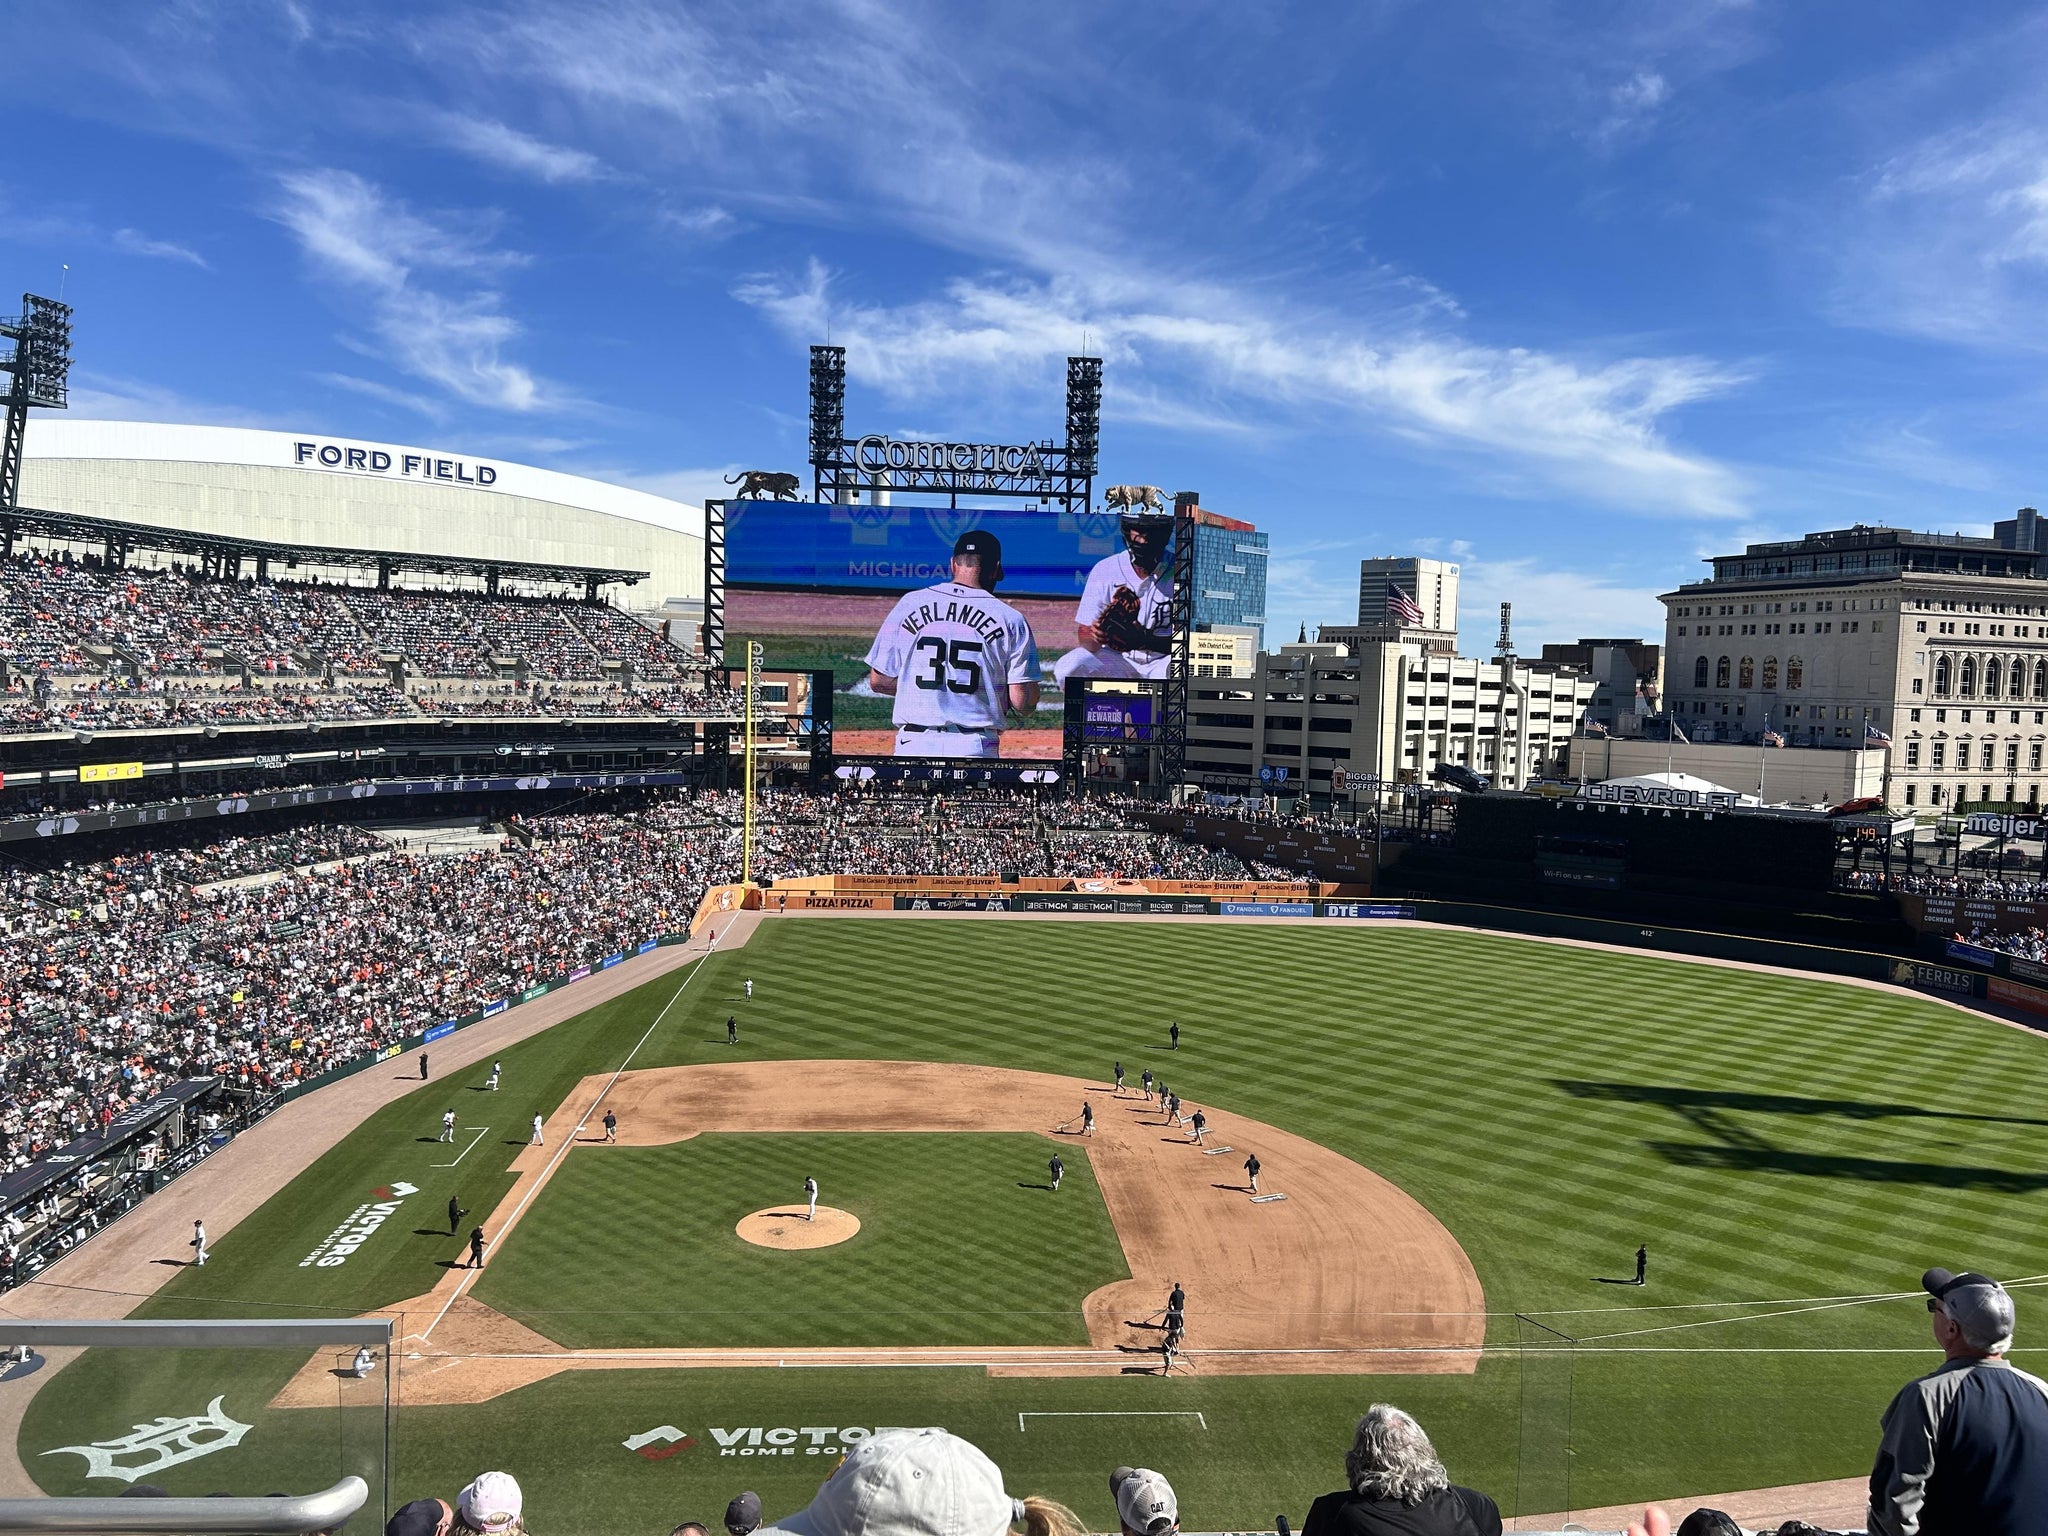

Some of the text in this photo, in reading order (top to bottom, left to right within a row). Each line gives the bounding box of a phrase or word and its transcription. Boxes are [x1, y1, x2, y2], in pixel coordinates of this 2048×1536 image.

[294, 441, 497, 487] FORD FIELD
[908, 471, 999, 489] PARK
[901, 602, 1005, 644] VERLANDER
[915, 636, 983, 695] 35
[751, 656, 764, 708] Rocket
[1086, 711, 1122, 722] REWARDS
[514, 742, 555, 751] Gallagher
[256, 753, 294, 765] CHAMPINS
[1345, 772, 1378, 781] BIGGBY
[1345, 782, 1378, 791] COFFEE
[1585, 783, 1742, 809] CHEVROLET
[1556, 801, 1714, 821] FOUNTAIN
[1968, 815, 2039, 837] meijer
[1286, 831, 1291, 839] 2
[1321, 836, 1329, 845] 16
[1266, 844, 1275, 853] 47
[1360, 843, 1366, 851] 6
[1543, 869, 1562, 878] Wi-Fi
[887, 877, 918, 885] DELIVERY
[966, 878, 996, 886] DELIVERY
[805, 898, 874, 908] PIZZA! PIZZA!
[1033, 902, 1068, 910] BETMGM
[1078, 902, 1113, 911] BETMGM
[1925, 899, 1956, 907] HEILMANN
[1965, 902, 1996, 911] JENNINGS
[1328, 905, 1358, 917] DTE
[1927, 907, 1953, 915] MANUSH
[2007, 905, 2036, 914] HARWELL
[1923, 915, 1955, 924] COCHRANE
[1963, 911, 1997, 920] CRAWFORD
[1971, 920, 1987, 928] KELL
[1917, 966, 1970, 987] FERRIS
[375, 1044, 402, 1062] bet365
[298, 1203, 372, 1267] HOME SOLUTIONS
[316, 1200, 405, 1267] VICTORS
[719, 1447, 795, 1456] HOME
[1150, 1501, 1165, 1513] CAT
